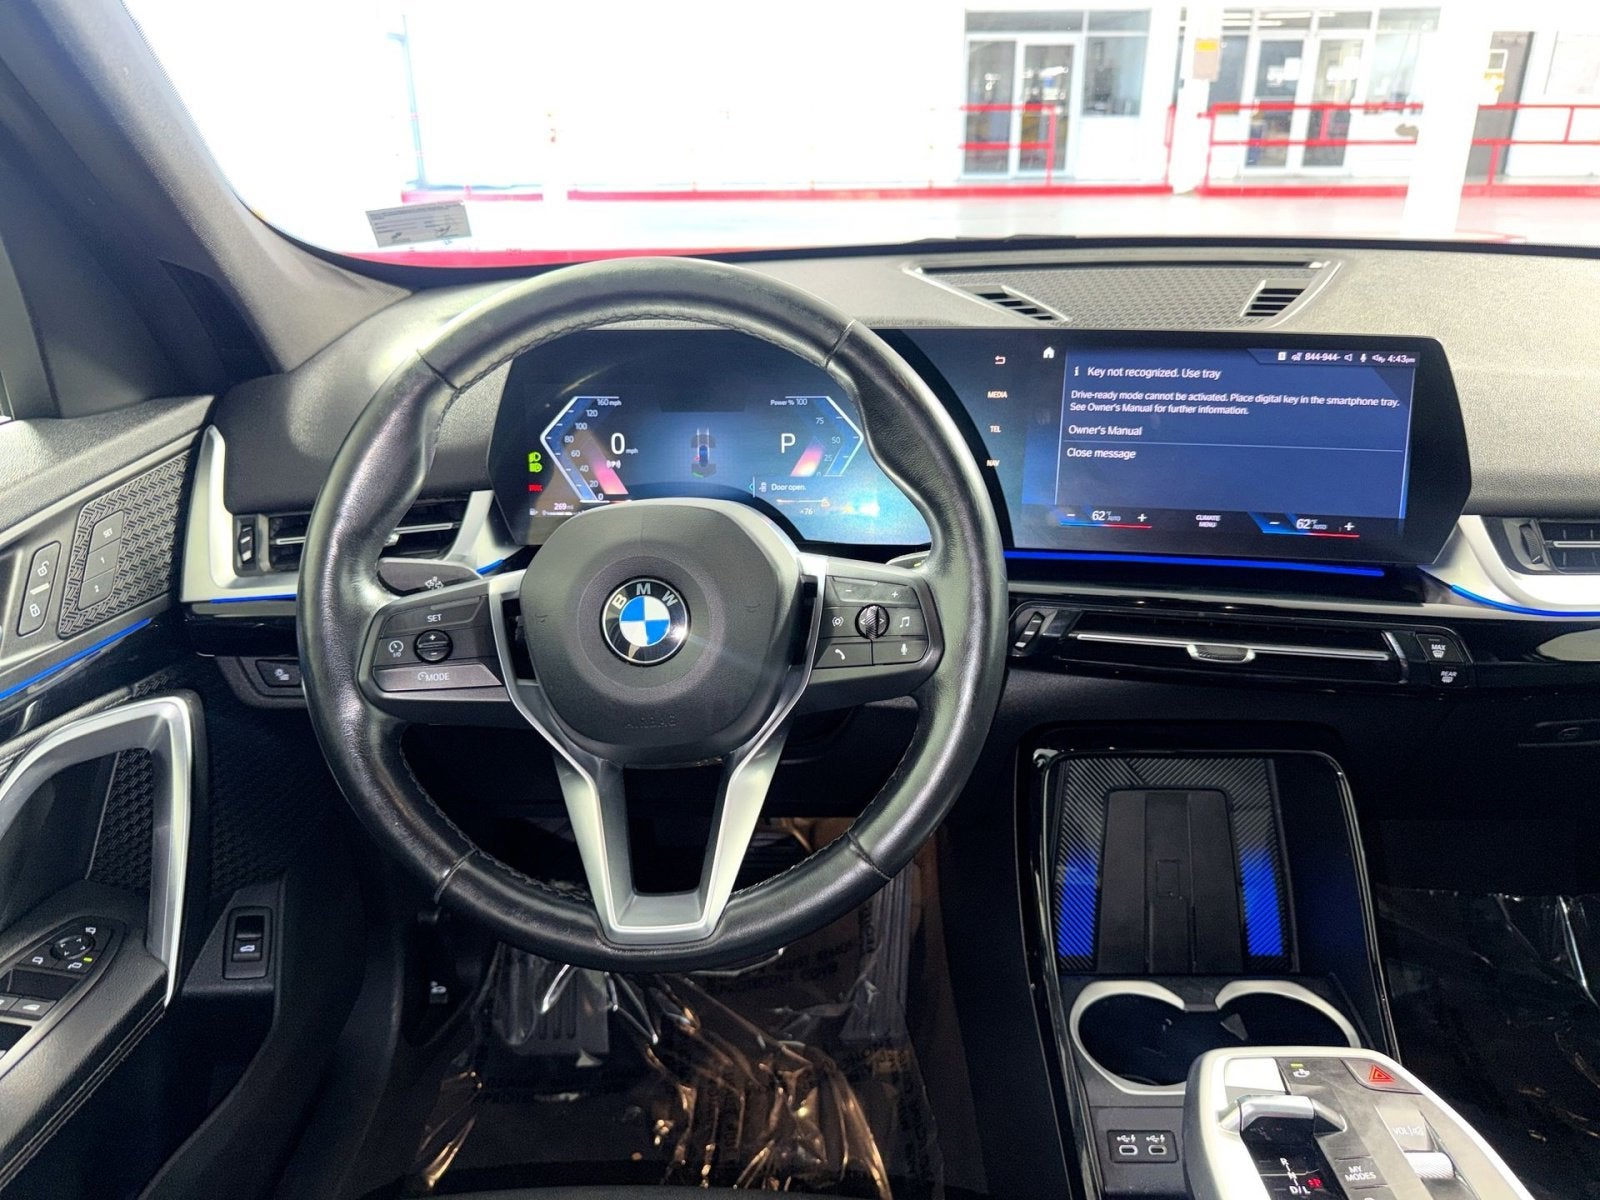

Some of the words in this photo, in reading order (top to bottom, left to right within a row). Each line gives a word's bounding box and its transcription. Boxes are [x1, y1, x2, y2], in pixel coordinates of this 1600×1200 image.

[1088, 366, 1106, 378] Key
[1107, 368, 1123, 376] not
[1125, 368, 1180, 379] recognized.
[1181, 368, 1200, 378] Use
[1202, 370, 1222, 380] tray
[987, 391, 1008, 399] MEDIA
[1070, 390, 1118, 402] Drive-ready
[1119, 391, 1142, 400] mode
[1144, 392, 1173, 400] cannot
[1174, 392, 1186, 400] be
[1188, 392, 1228, 402] activated.
[1230, 393, 1254, 402] Place
[1254, 393, 1282, 404] digital
[1283, 394, 1300, 405] key
[1300, 394, 1309, 404] in
[1310, 395, 1324, 404] the
[1326, 395, 1378, 408] smartphone
[1380, 396, 1400, 408] tray.
[1070, 402, 1086, 412] See
[1087, 403, 1120, 412] Owner's
[1122, 404, 1152, 413] Manual
[1154, 404, 1166, 412] for
[1168, 404, 1196, 414] further
[1198, 405, 1250, 416] information.
[990, 425, 1002, 433] TEL
[1068, 424, 1106, 435] Owner's
[1107, 426, 1142, 436] Manual
[610, 432, 626, 454] 0
[781, 433, 796, 454] P
[1066, 448, 1092, 458] Close
[1094, 450, 1136, 460] message
[986, 459, 1000, 467] NAV
[590, 480, 599, 488] 20
[770, 483, 788, 492] Door
[612, 582, 678, 610] BMW
[426, 614, 442, 622] SET
[426, 672, 450, 681] MODE
[1348, 1166, 1362, 1175] MY
[1344, 1172, 1377, 1182] MODES
